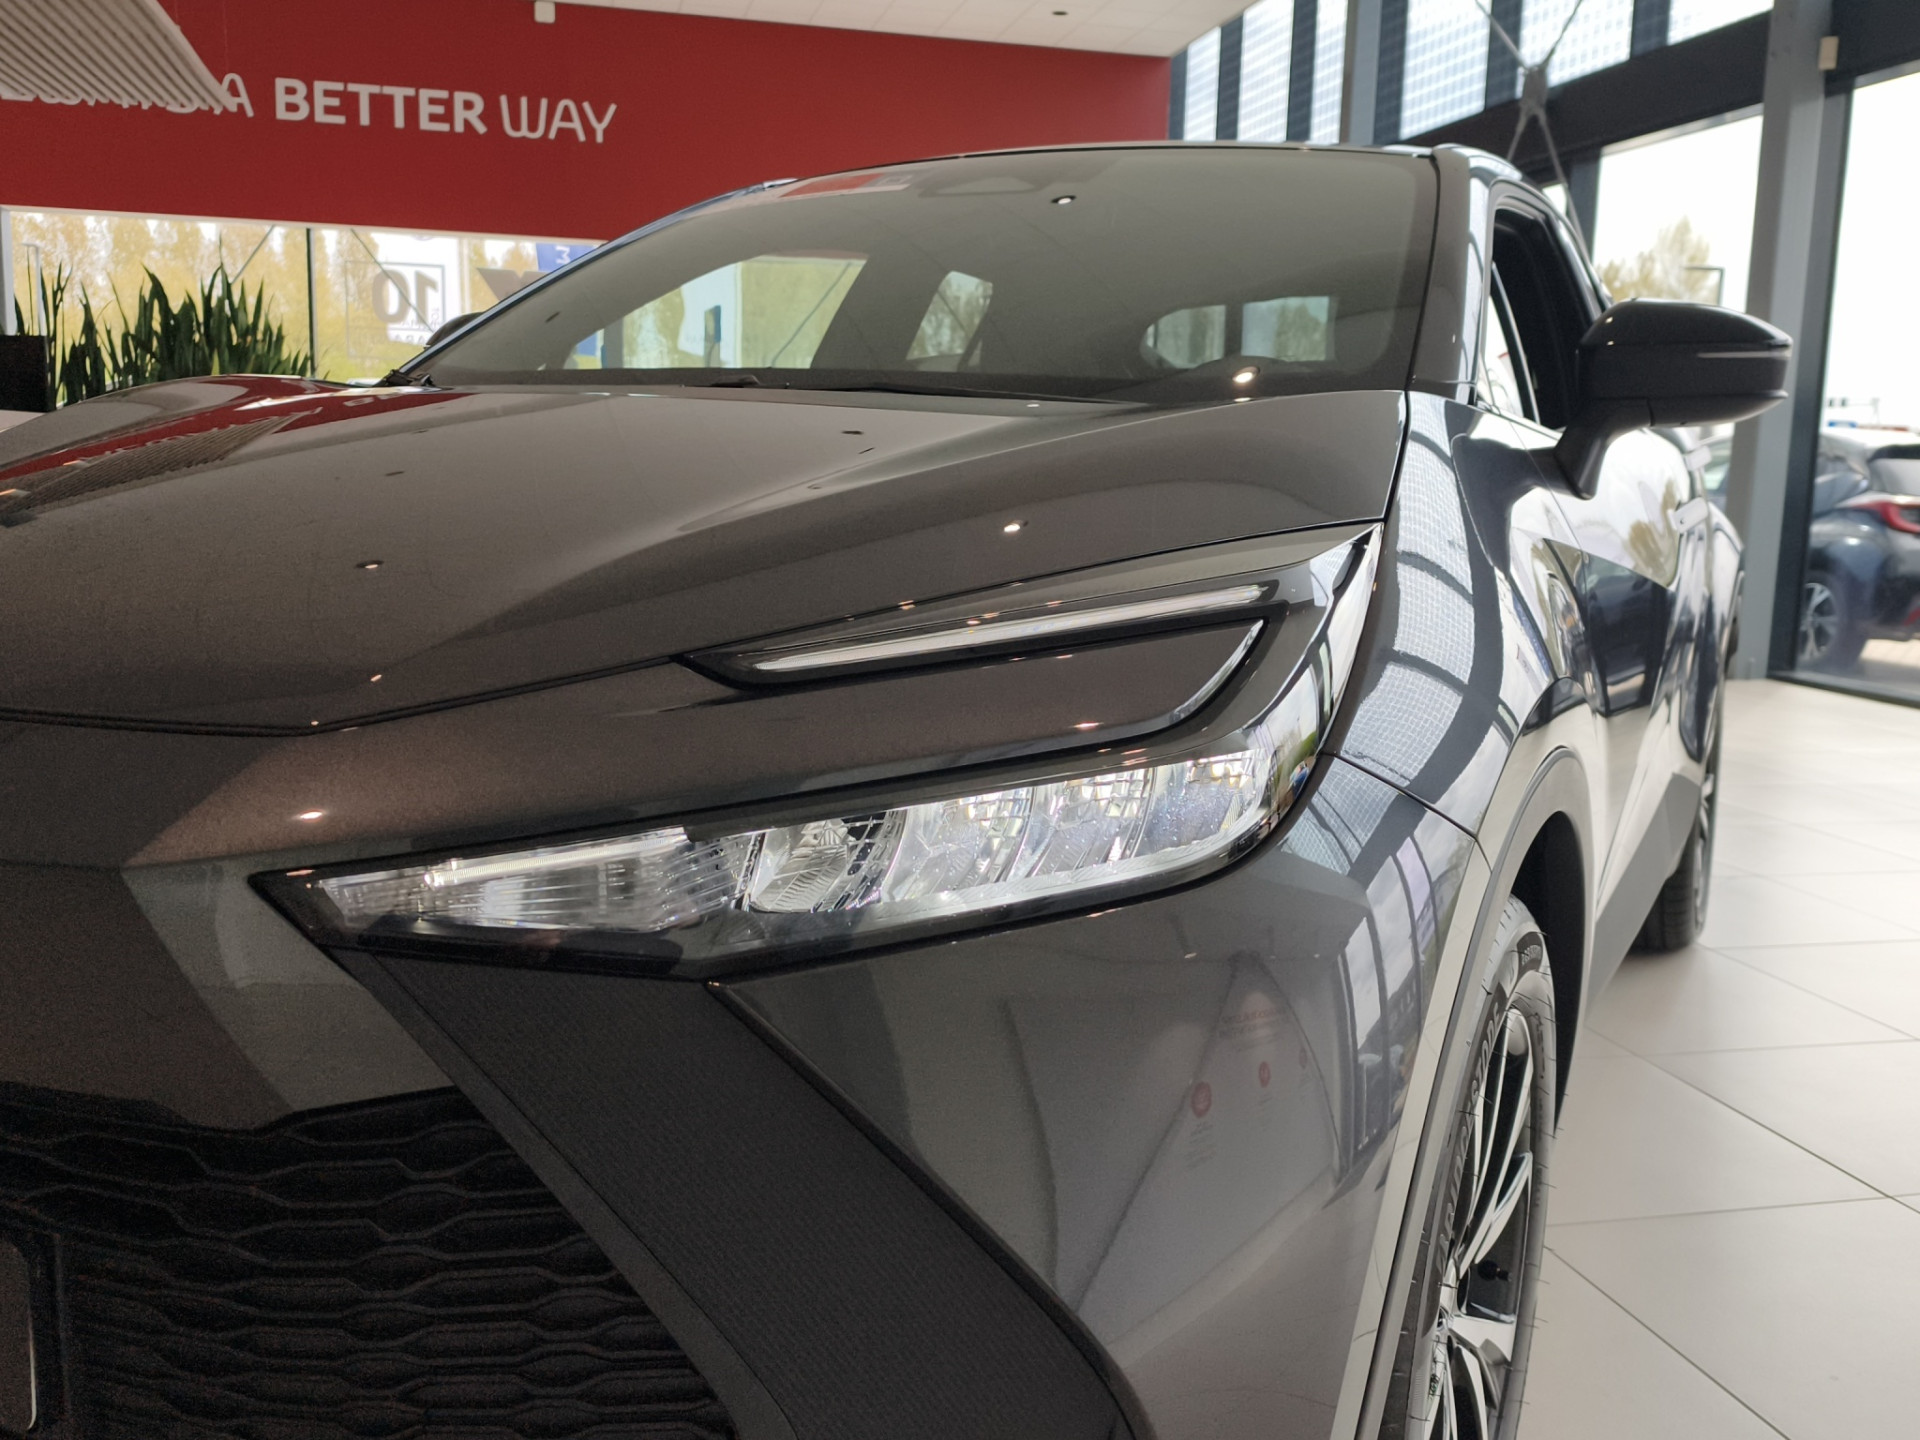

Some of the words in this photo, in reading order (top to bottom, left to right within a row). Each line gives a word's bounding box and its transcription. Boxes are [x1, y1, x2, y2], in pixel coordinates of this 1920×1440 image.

[221, 72, 254, 118] A
[274, 77, 488, 135] BETTER
[499, 94, 617, 143] WAY
